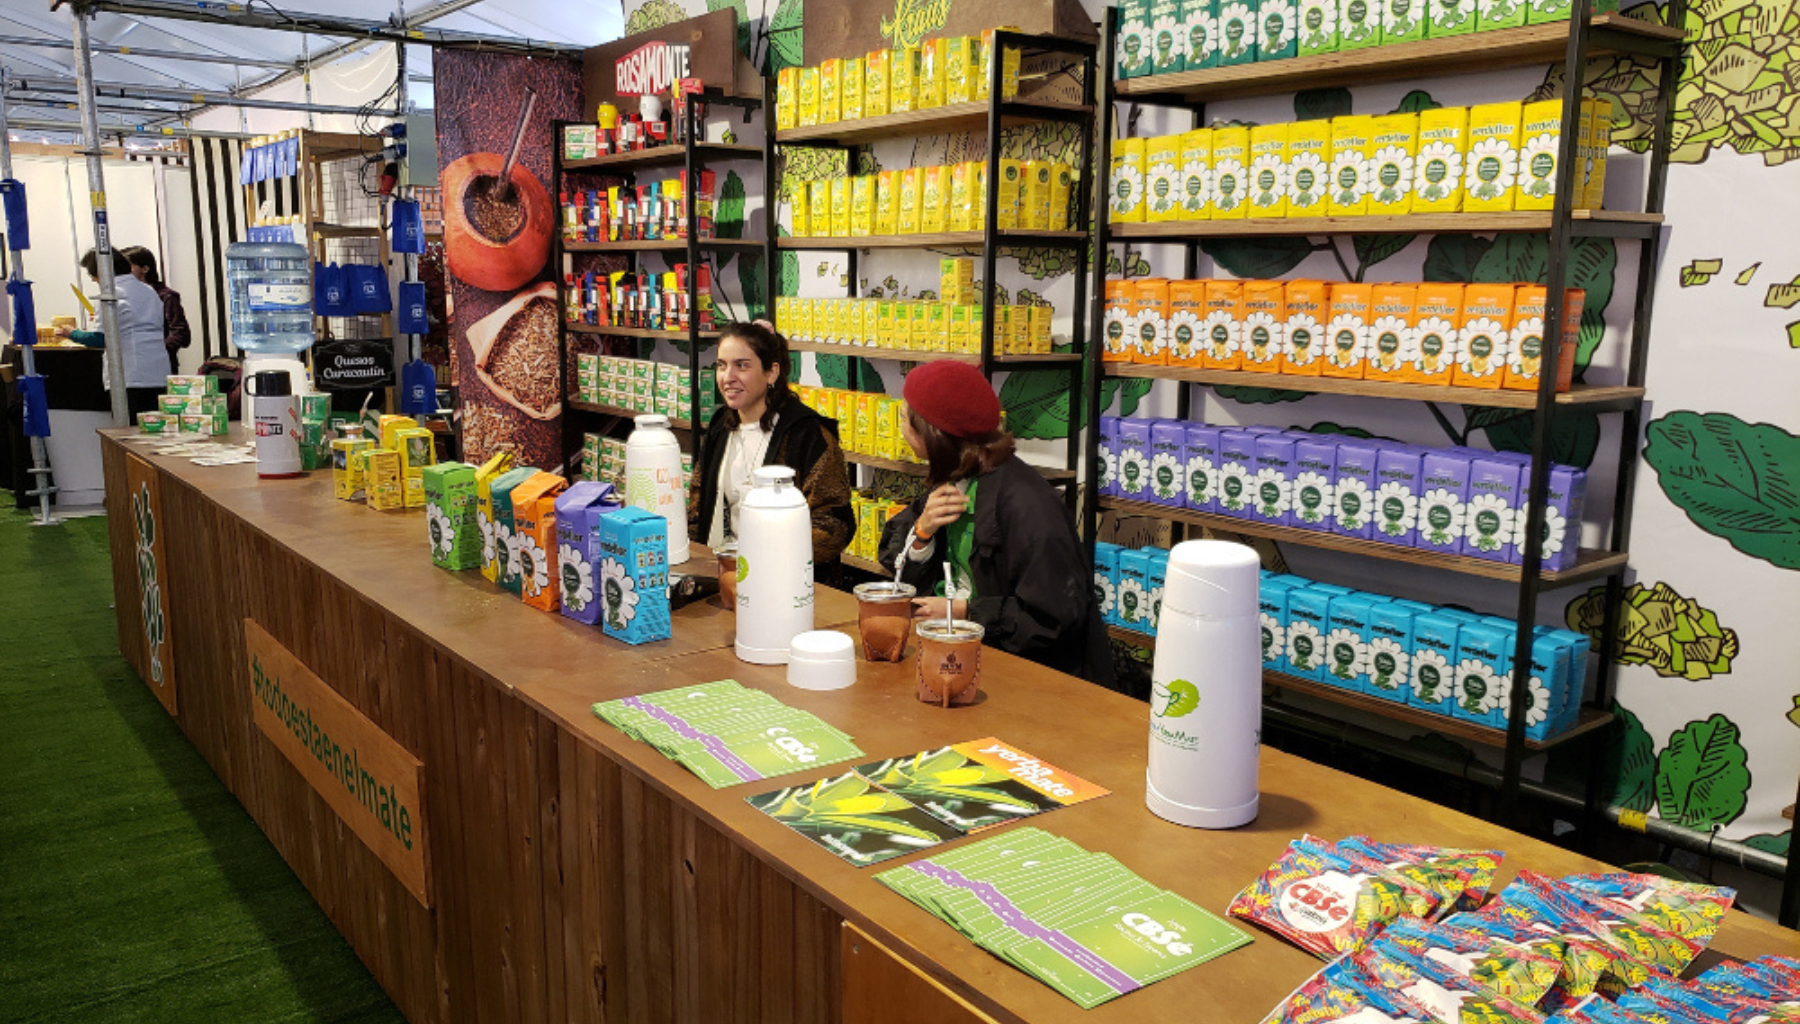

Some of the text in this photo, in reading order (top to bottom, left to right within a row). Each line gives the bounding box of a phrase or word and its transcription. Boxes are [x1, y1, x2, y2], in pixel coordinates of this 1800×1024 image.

[617, 45, 690, 94] ROSAMONTE
[334, 355, 375, 367] Quesos
[252, 653, 413, 850] #todoestaenelmate
[979, 743, 1054, 777] yerba
[1008, 766, 1074, 798] mate
[1288, 883, 1350, 922] CBSé
[1121, 912, 1194, 957] CBSé
